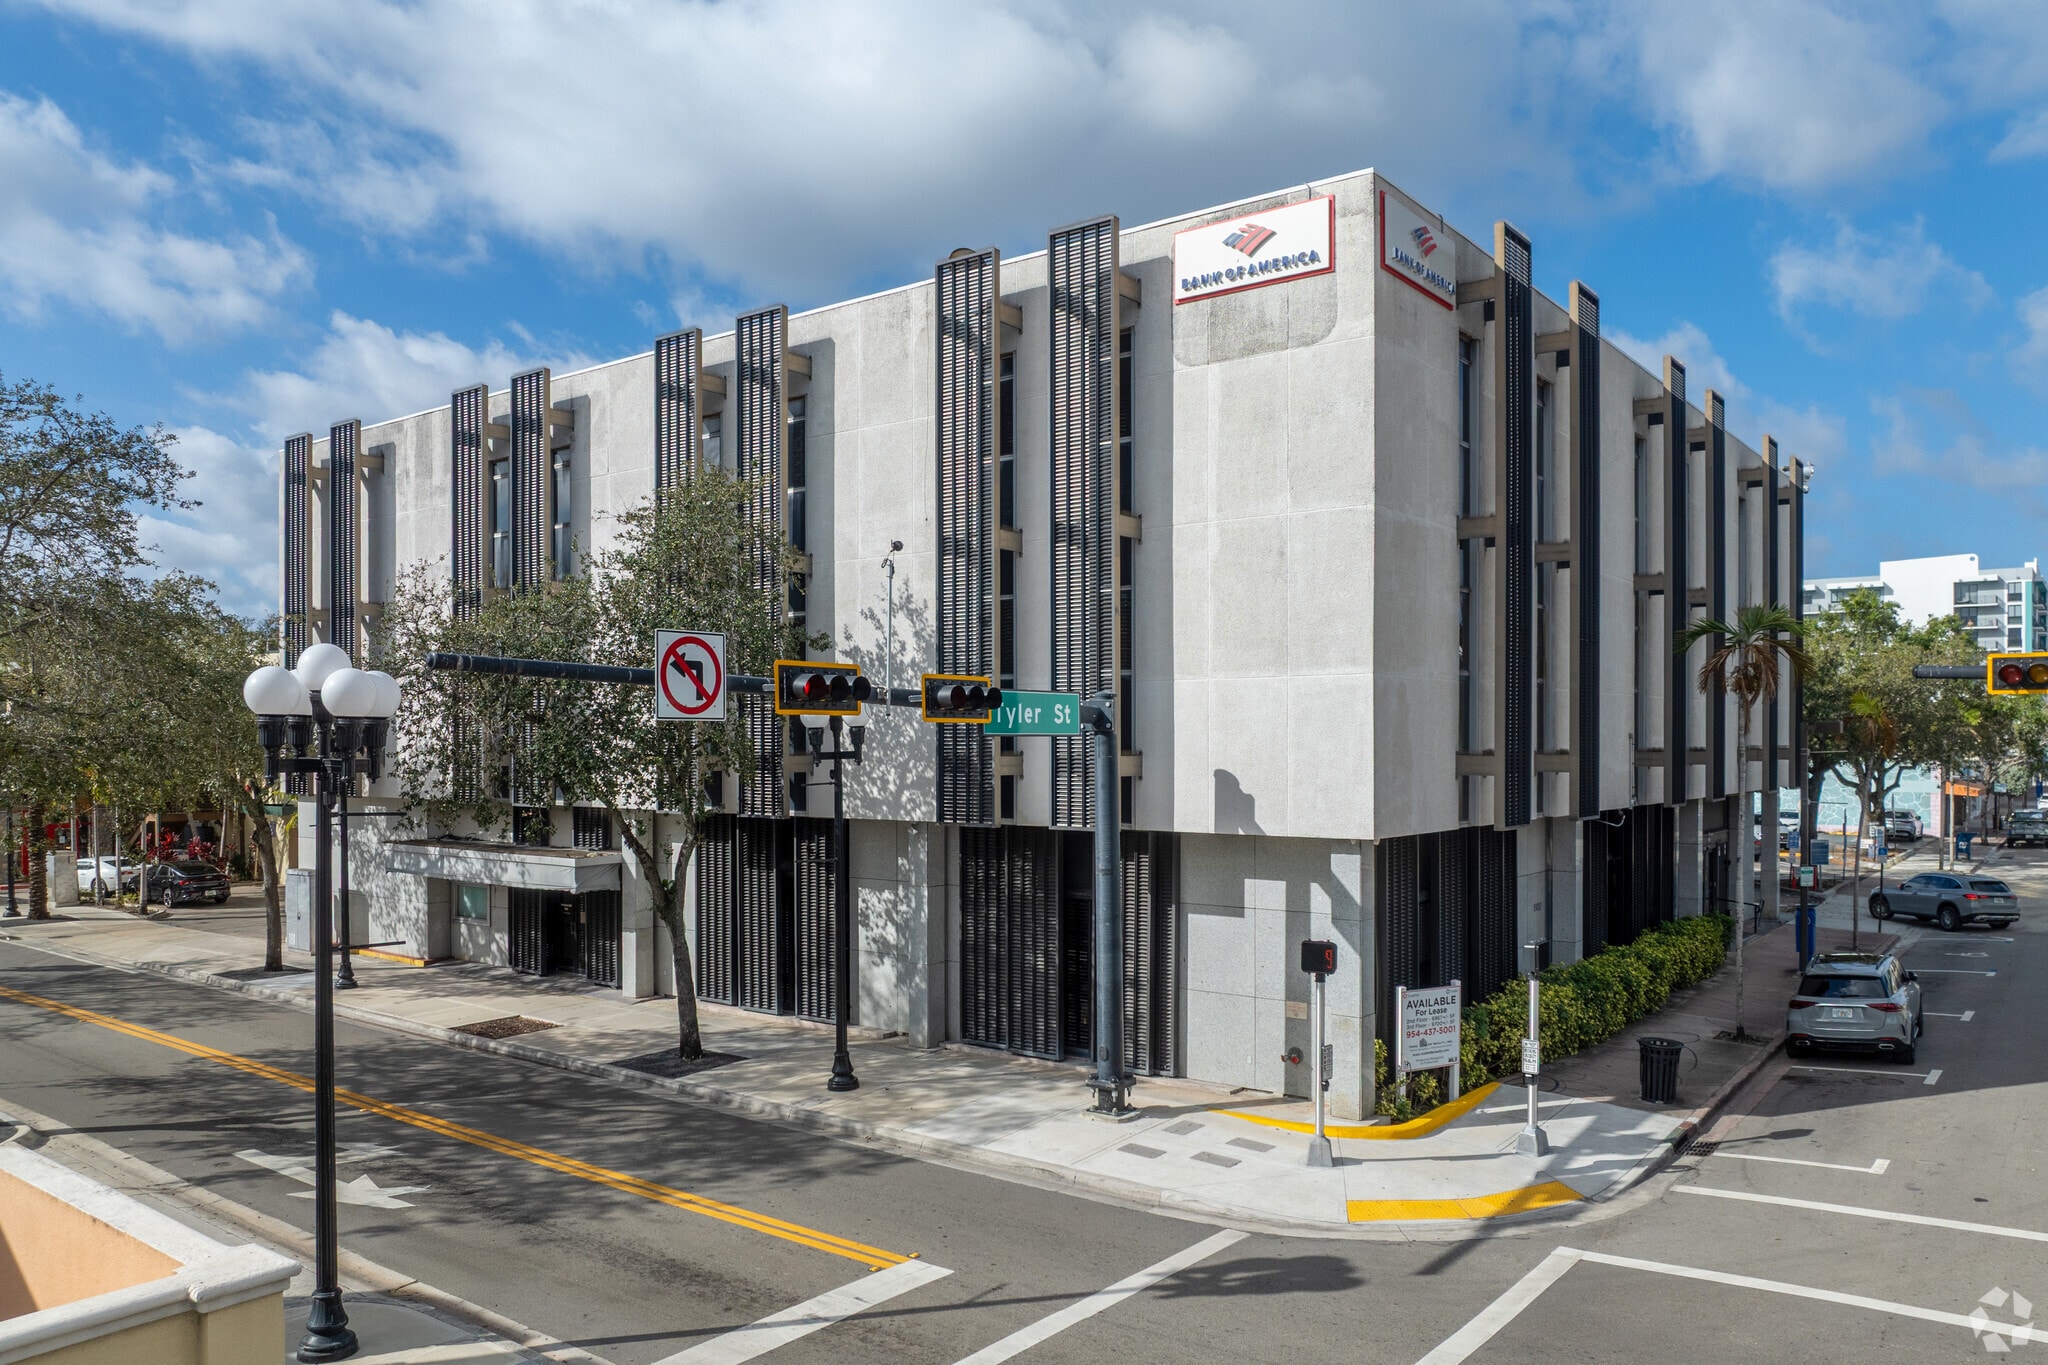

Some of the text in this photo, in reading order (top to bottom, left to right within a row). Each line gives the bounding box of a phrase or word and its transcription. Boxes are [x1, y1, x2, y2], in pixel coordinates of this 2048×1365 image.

[1182, 250, 1320, 291] BANK OF AMERICA
[1393, 246, 1456, 295] BANK OF AMERICA
[1054, 703, 1071, 724] St
[1406, 995, 1457, 1010] AVAILABLE
[1415, 1007, 1448, 1017] For Lease
[1406, 1025, 1456, 1039] 954-437-5001
